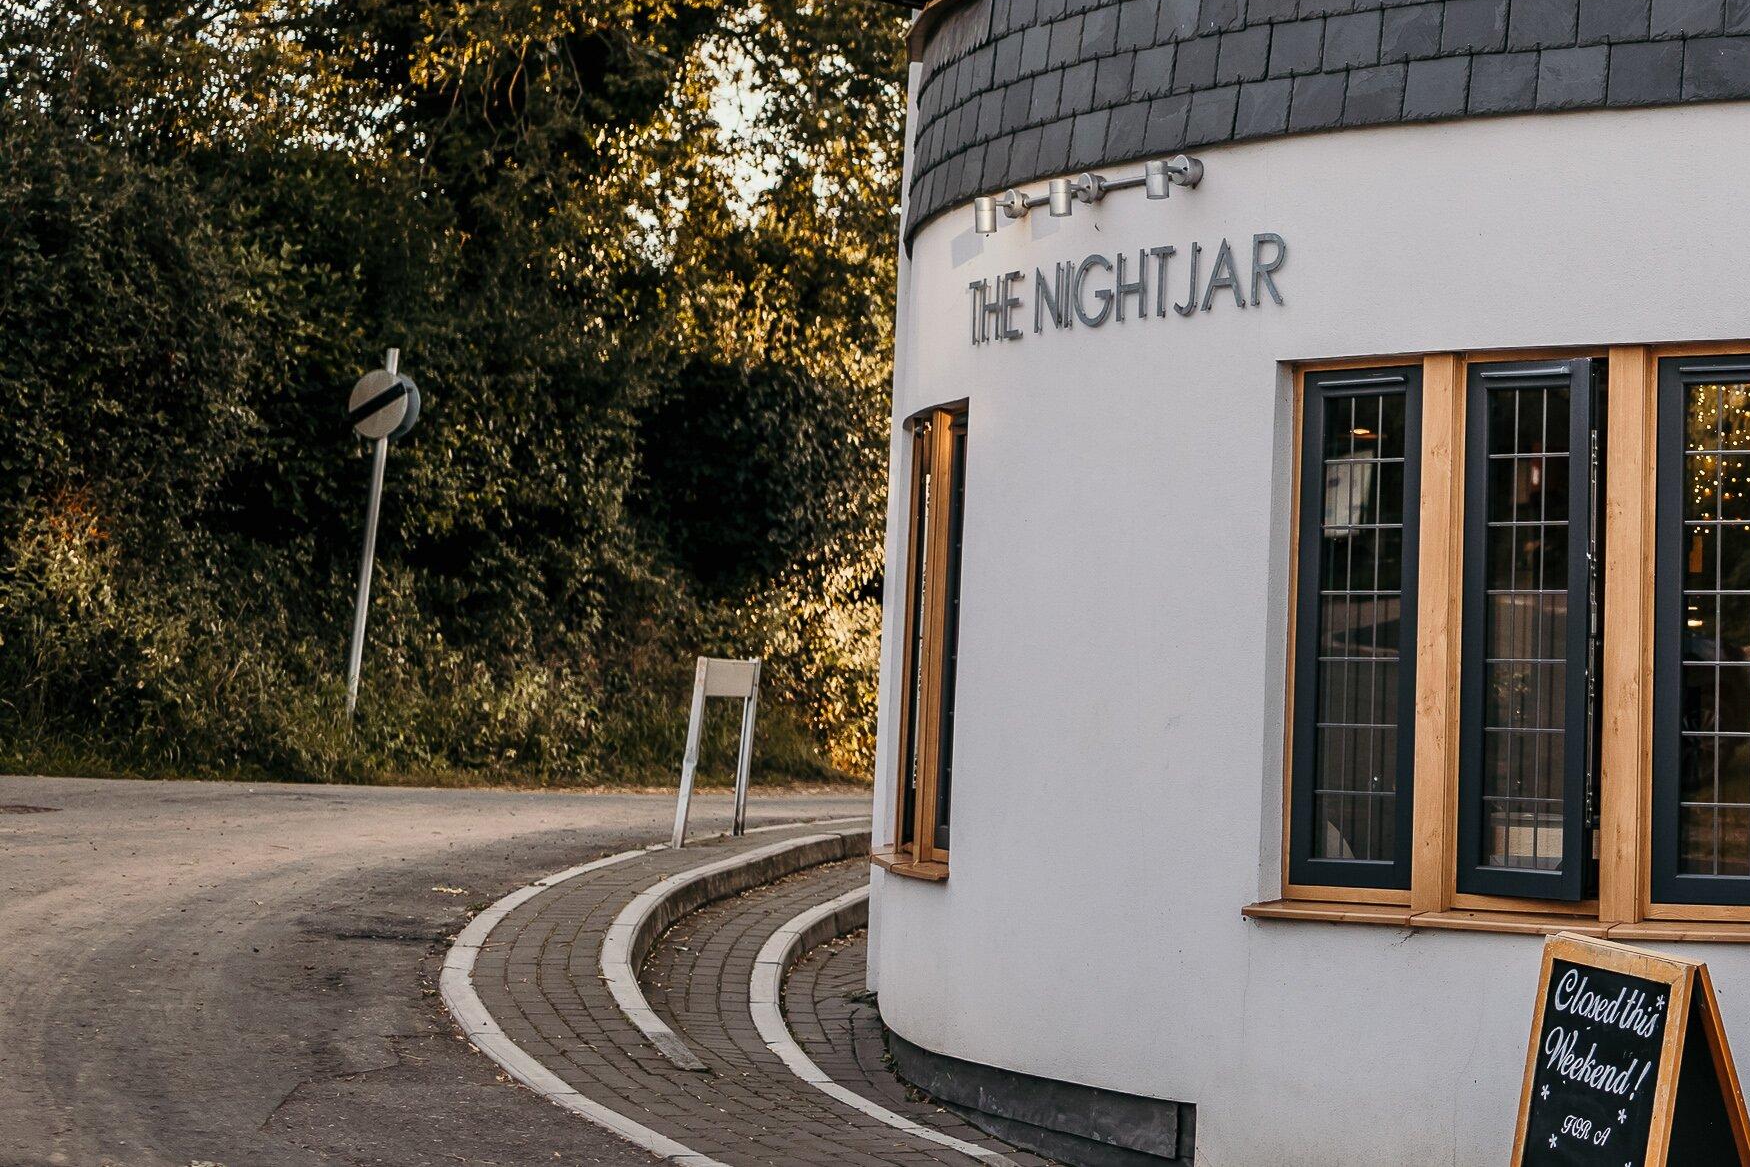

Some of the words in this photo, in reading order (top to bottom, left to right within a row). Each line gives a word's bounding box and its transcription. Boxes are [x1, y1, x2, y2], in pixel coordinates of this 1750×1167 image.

[969, 270, 1026, 346] THE
[1033, 232, 1288, 334] NIGHTJAR
[1554, 968, 1628, 1024] Closed
[1619, 988, 1660, 1038] this
[1560, 1114, 1591, 1140] FOR
[1593, 1126, 1612, 1147] A
